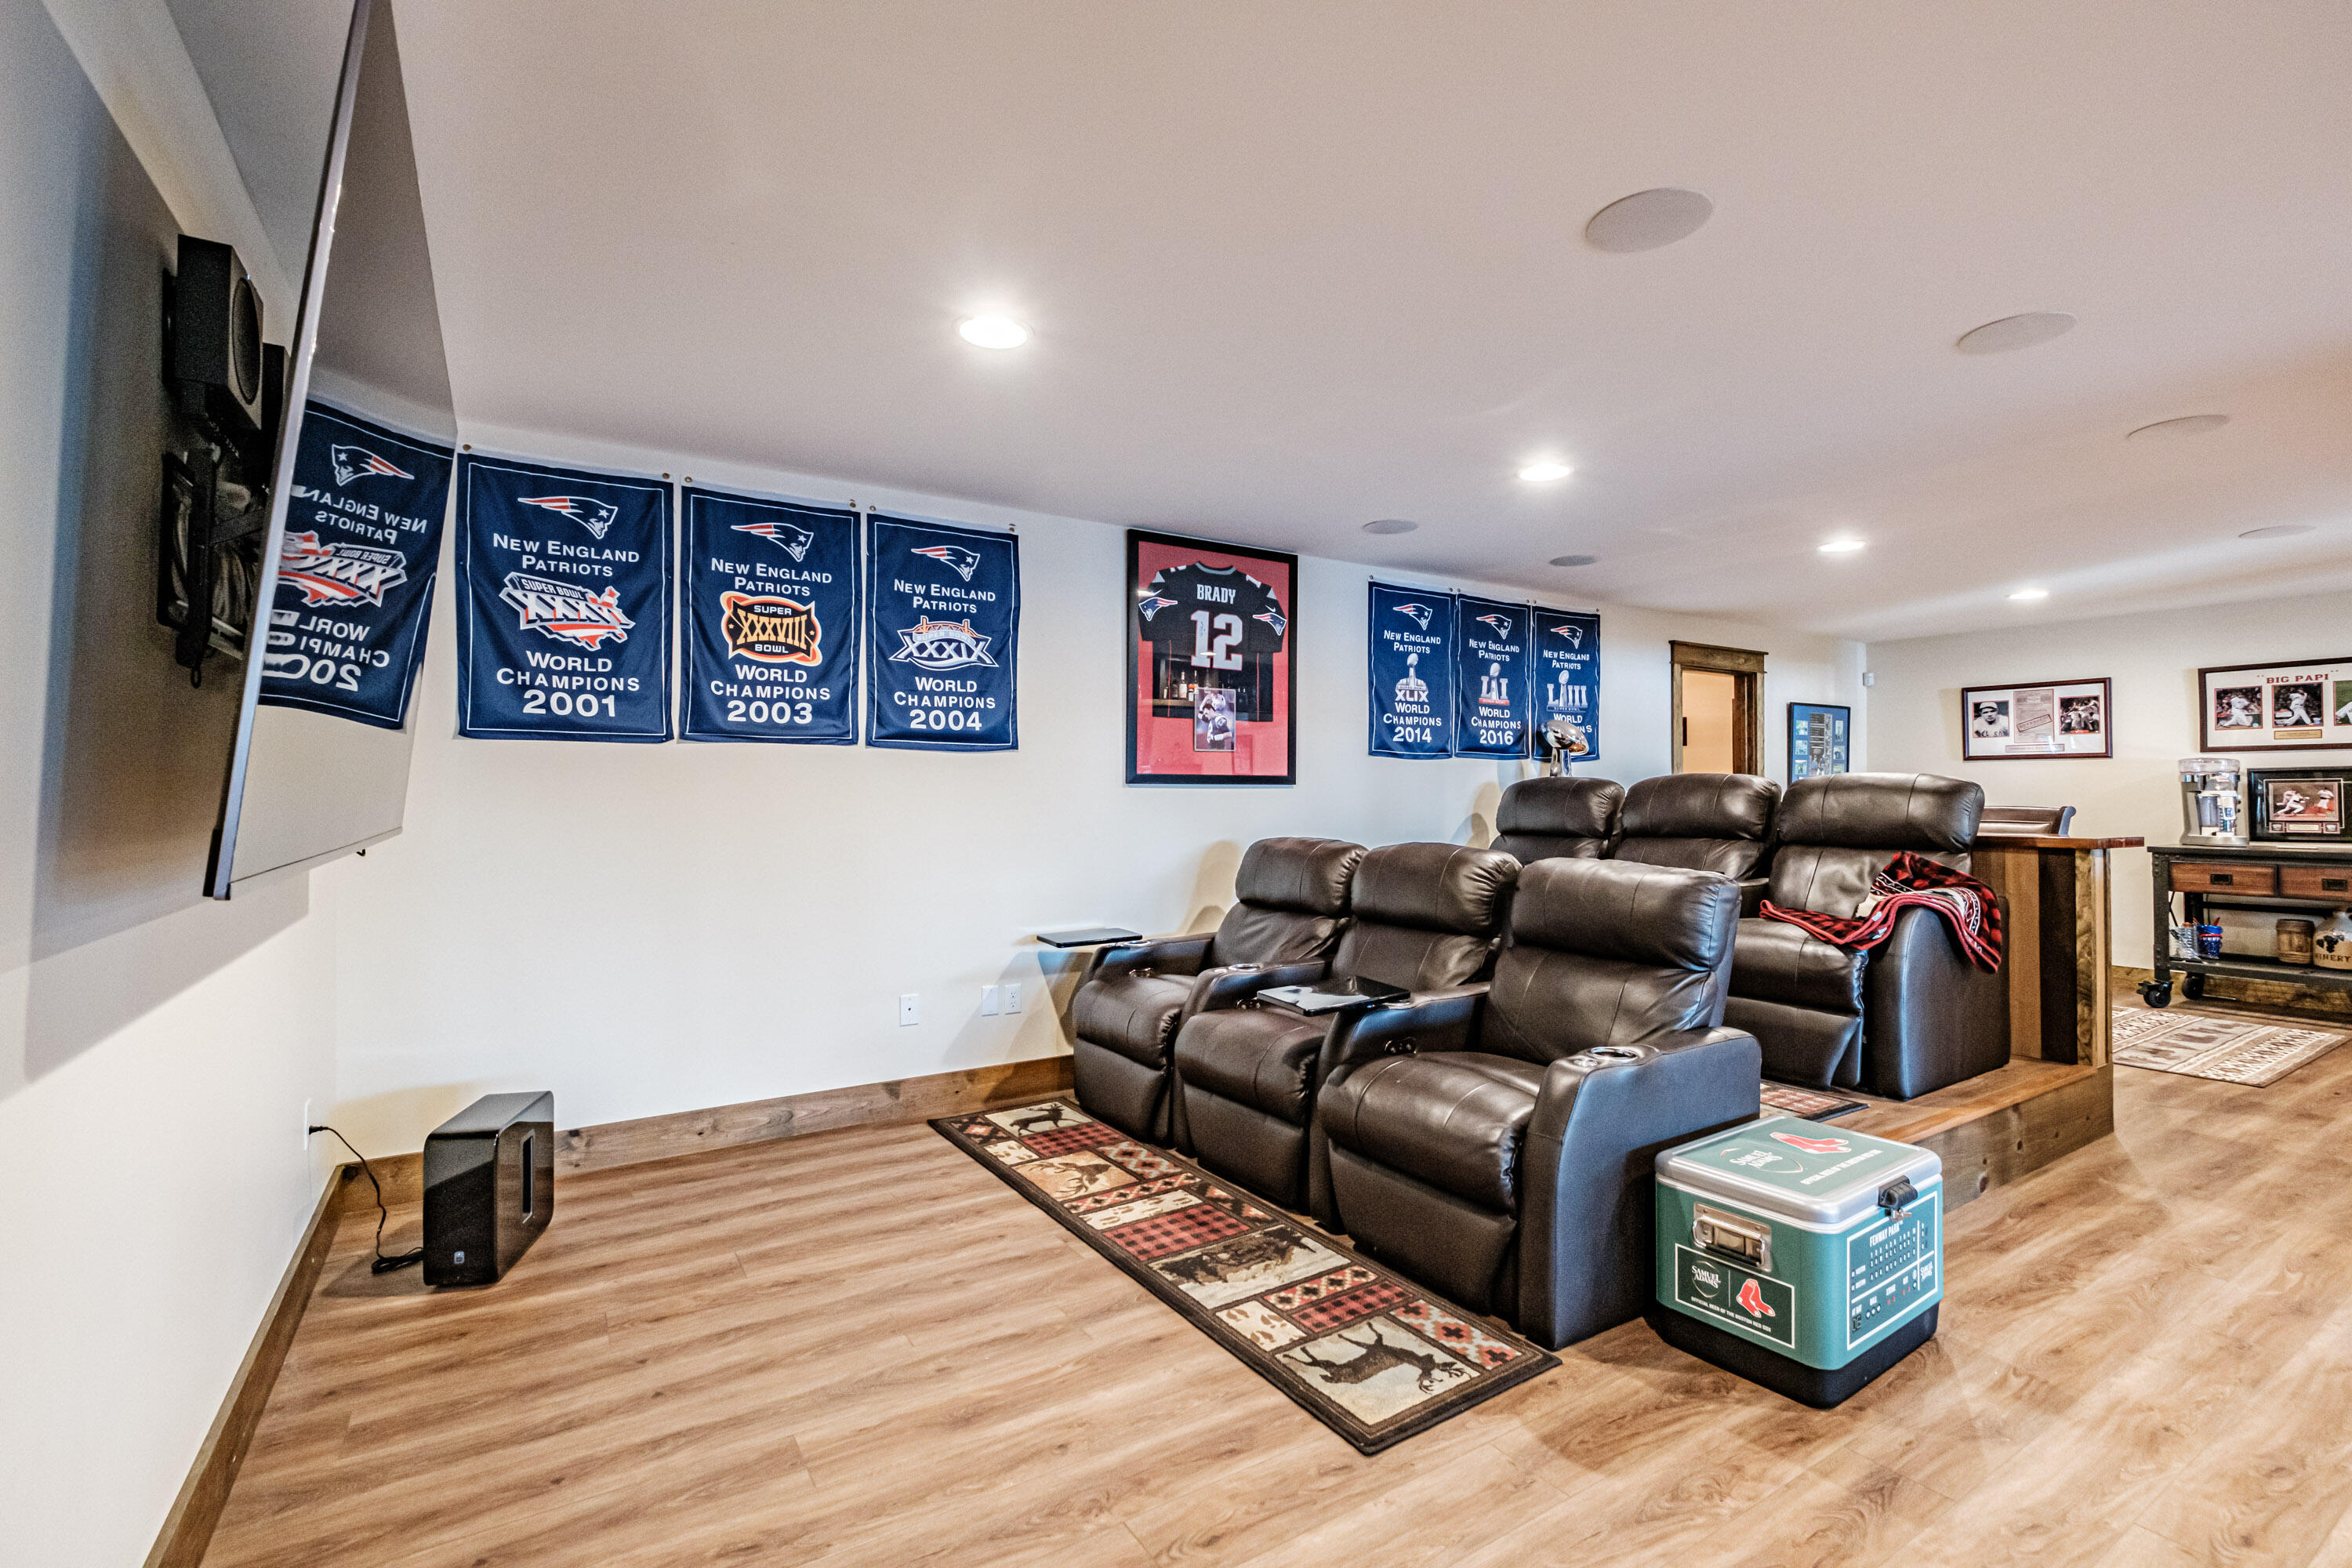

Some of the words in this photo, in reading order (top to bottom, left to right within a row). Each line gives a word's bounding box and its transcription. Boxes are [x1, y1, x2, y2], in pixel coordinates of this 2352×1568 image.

[493, 533, 539, 553] NEW
[548, 540, 640, 562] ENGLAND
[522, 555, 613, 577] PATRIOTS
[711, 557, 750, 575] NEW
[756, 563, 833, 583] ENGLAND
[521, 579, 555, 594] SUPER
[557, 586, 585, 600] BOWL
[735, 576, 811, 597] PATRIOTS
[895, 579, 926, 593] NEW
[931, 584, 996, 601] ENGLAND
[1196, 583, 1236, 604] BRADY
[753, 604, 792, 615] SUPER
[913, 597, 977, 613] PATRIOTS
[737, 608, 808, 651] XXXVIII
[1384, 630, 1401, 641] NEW
[1403, 633, 1441, 644] ENGLAND
[755, 644, 788, 654] BOWL
[1190, 610, 1243, 671] 12
[1393, 642, 1430, 653] PATRIOTS
[1469, 638, 1486, 648] NEW
[1489, 641, 1519, 653] ENGLAND
[898, 636, 993, 664] XXXIX
[1479, 650, 1510, 662] PATRIOTS
[1543, 650, 1559, 659] NEW
[1559, 652, 1590, 661] ENGLAND
[526, 650, 612, 672] WORLD
[1552, 660, 1581, 670] PATRIOTS
[496, 668, 640, 691] CHAMPIONS
[735, 664, 808, 683] WORLD
[2295, 673, 2329, 682] PAPI
[710, 681, 830, 700] CHAMPIONS
[915, 677, 977, 692] WORLD
[1481, 676, 1508, 700] LI
[523, 689, 615, 717] 2001
[894, 691, 996, 709] CHAMPIONS
[1395, 690, 1428, 702] XLIX
[1547, 684, 1588, 707] LIII
[727, 700, 812, 724] 2003
[1395, 702, 1430, 713] WORLD
[1479, 706, 1510, 718] WORLD
[909, 709, 982, 731] 2004
[1383, 713, 1442, 726] CHAMPIONS
[1471, 717, 1521, 729] CHAMPIONS
[1553, 713, 1582, 724] WORLD
[1392, 727, 1432, 742] 2014
[1479, 729, 1514, 746] 2016
[1692, 1265, 1722, 1283] SAMUEL
[1694, 1273, 1719, 1289] ADAMS
